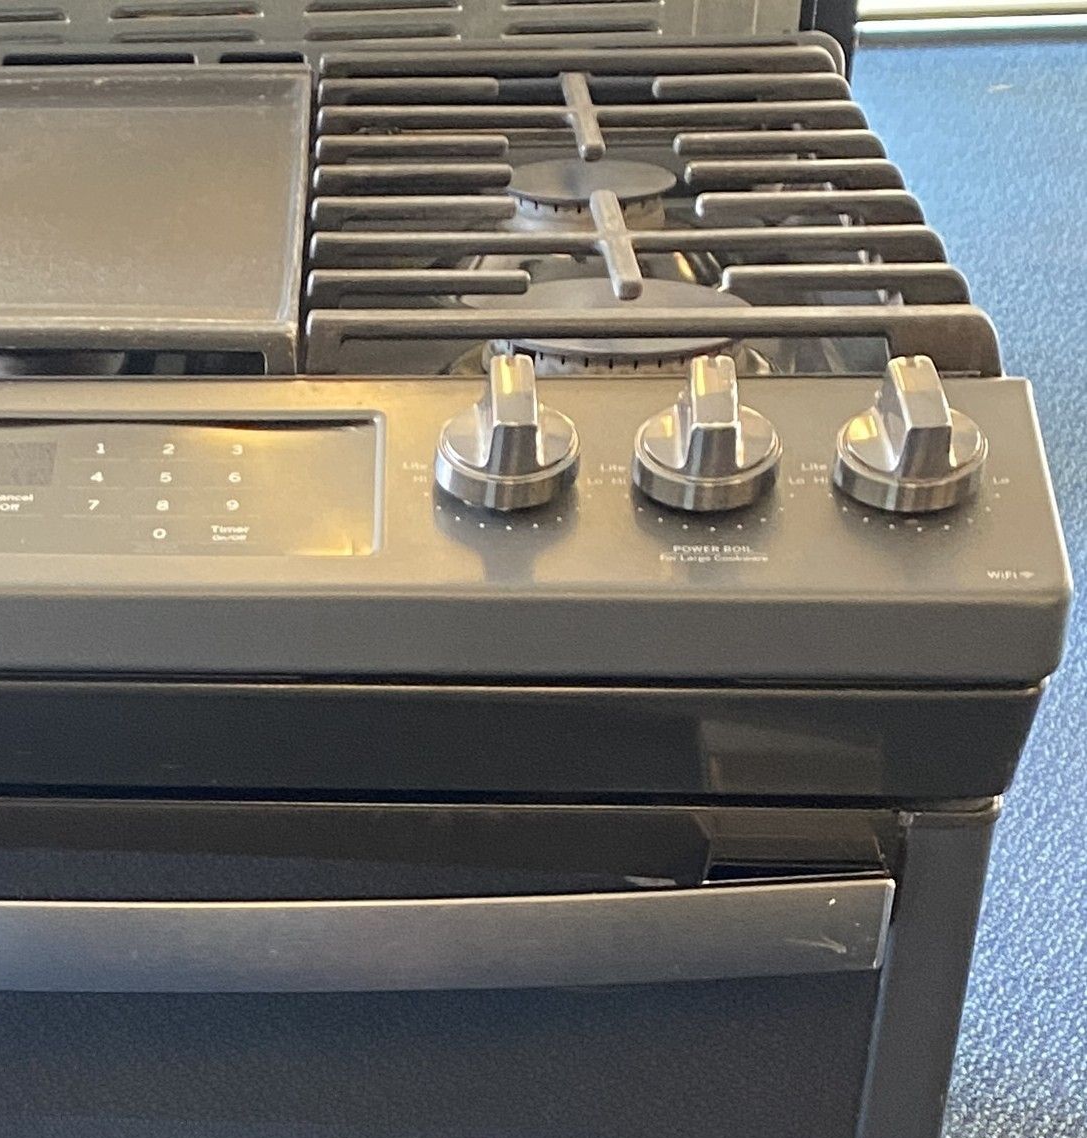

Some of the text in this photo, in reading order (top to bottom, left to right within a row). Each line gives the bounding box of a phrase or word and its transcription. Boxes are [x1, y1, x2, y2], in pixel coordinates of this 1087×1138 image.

[96, 443, 106, 454] 1
[162, 443, 175, 455] 2
[232, 443, 243, 455] 3
[801, 462, 827, 471] Lite
[90, 472, 104, 482] 4
[159, 471, 172, 483] 5
[228, 471, 241, 483] 6
[993, 476, 1009, 484] Lo
[0, 502, 20, 511] Off
[88, 500, 100, 511] 7
[156, 500, 169, 511] 8
[226, 500, 239, 511] 9
[211, 525, 249, 534] Timer
[673, 545, 751, 553] POWER BOIL
[680, 554, 712, 563] Large
[714, 554, 768, 562] Cookware
[987, 570, 1018, 580] WiFi
